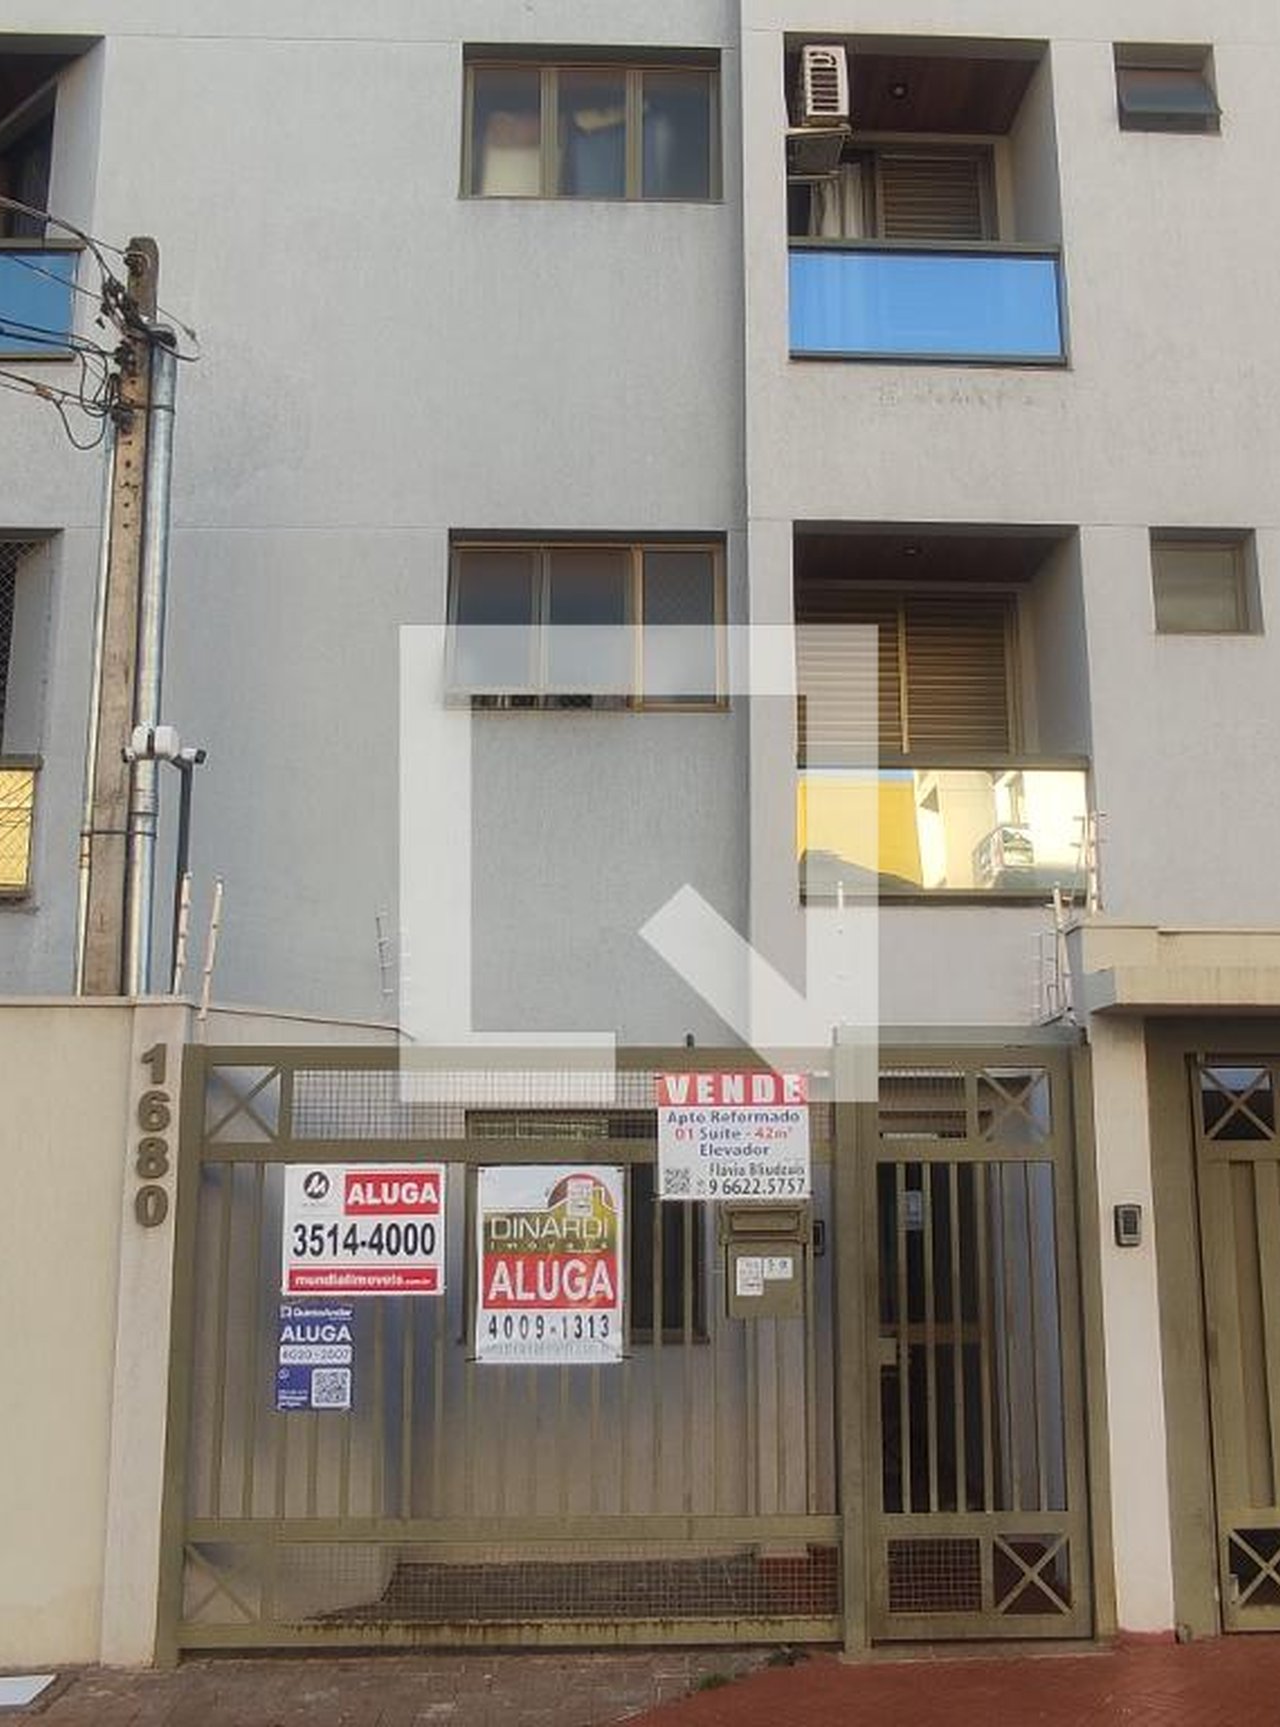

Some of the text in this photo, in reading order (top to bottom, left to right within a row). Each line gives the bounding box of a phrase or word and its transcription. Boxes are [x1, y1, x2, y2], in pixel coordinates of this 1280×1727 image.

[665, 1074, 804, 1104] VENDE
[668, 1110, 800, 1125] Apto Reformado
[135, 1042, 170, 1229] 1680
[675, 1128, 694, 1140] 01
[700, 1145, 770, 1157] Elevador
[347, 1182, 438, 1205] ALUGA
[709, 1178, 805, 1195] 9 6622.5757
[293, 1222, 436, 1256] 3514-4000
[491, 1217, 608, 1240] DINARDI
[488, 1260, 614, 1300] ALUGA
[280, 1325, 352, 1342] ALUGA
[488, 1315, 610, 1340] 4009-1313
